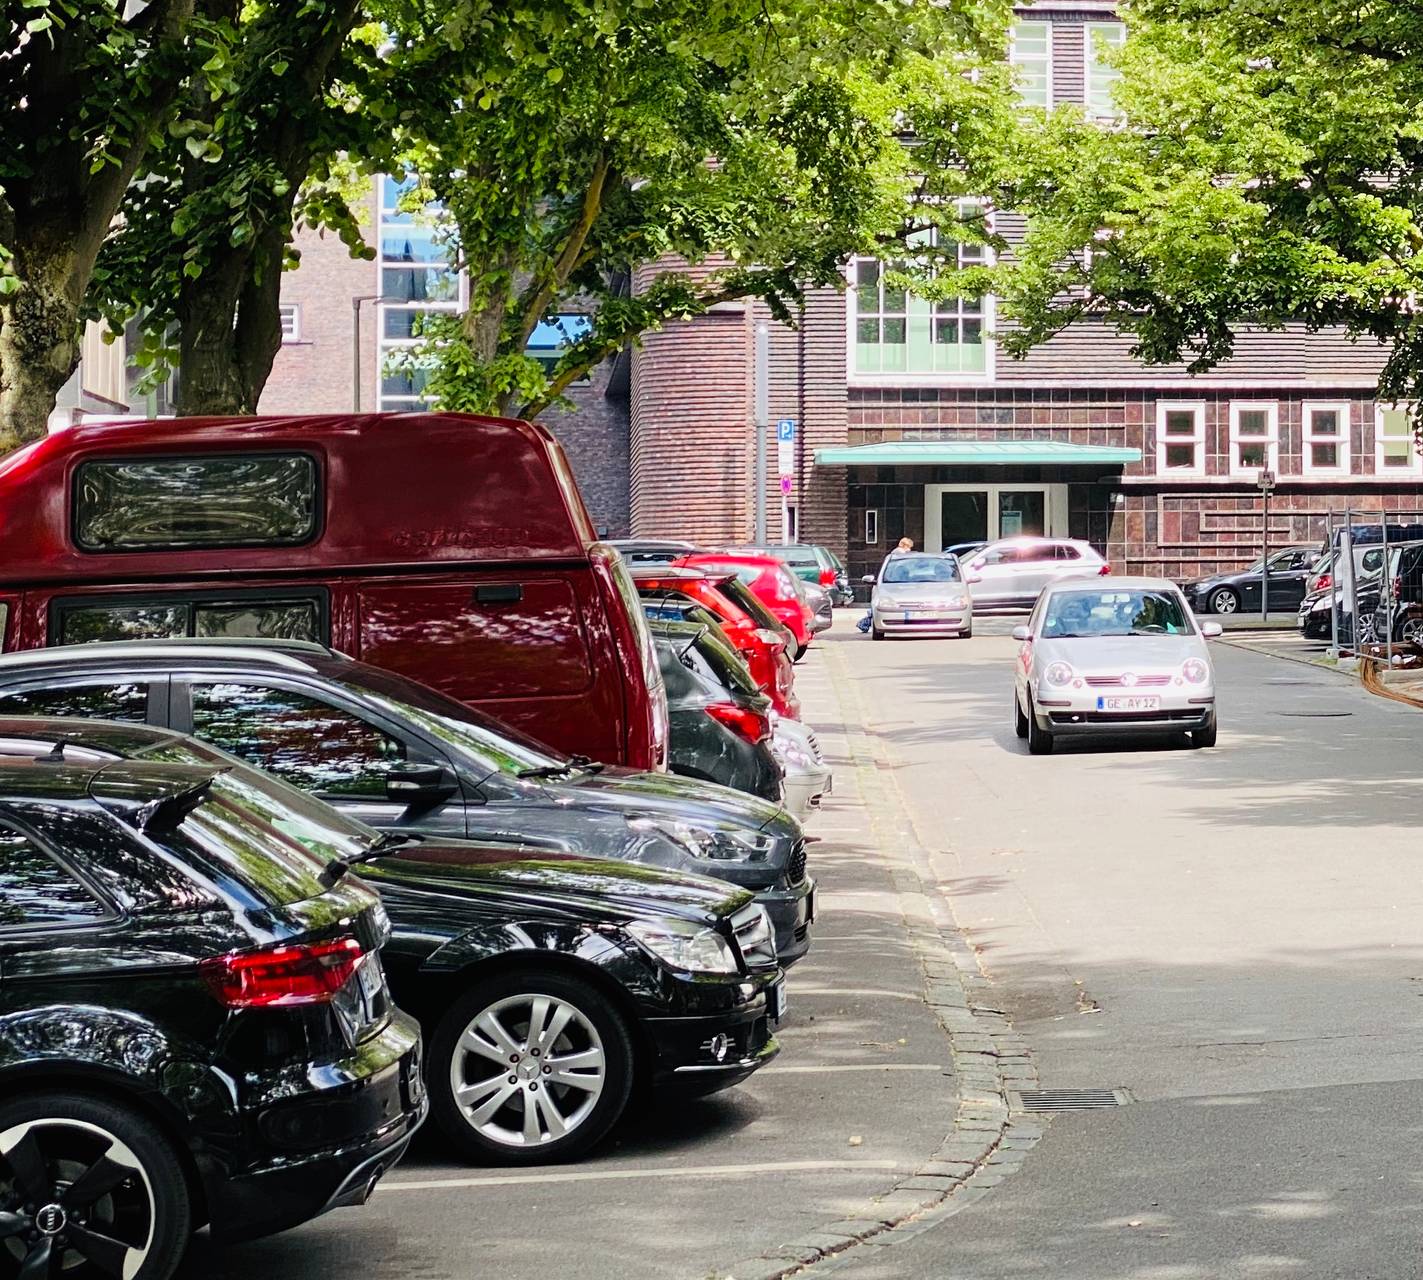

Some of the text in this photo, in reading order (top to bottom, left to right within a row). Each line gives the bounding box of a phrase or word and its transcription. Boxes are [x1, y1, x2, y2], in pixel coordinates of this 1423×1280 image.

[1107, 698, 1156, 709] GE AY 12
